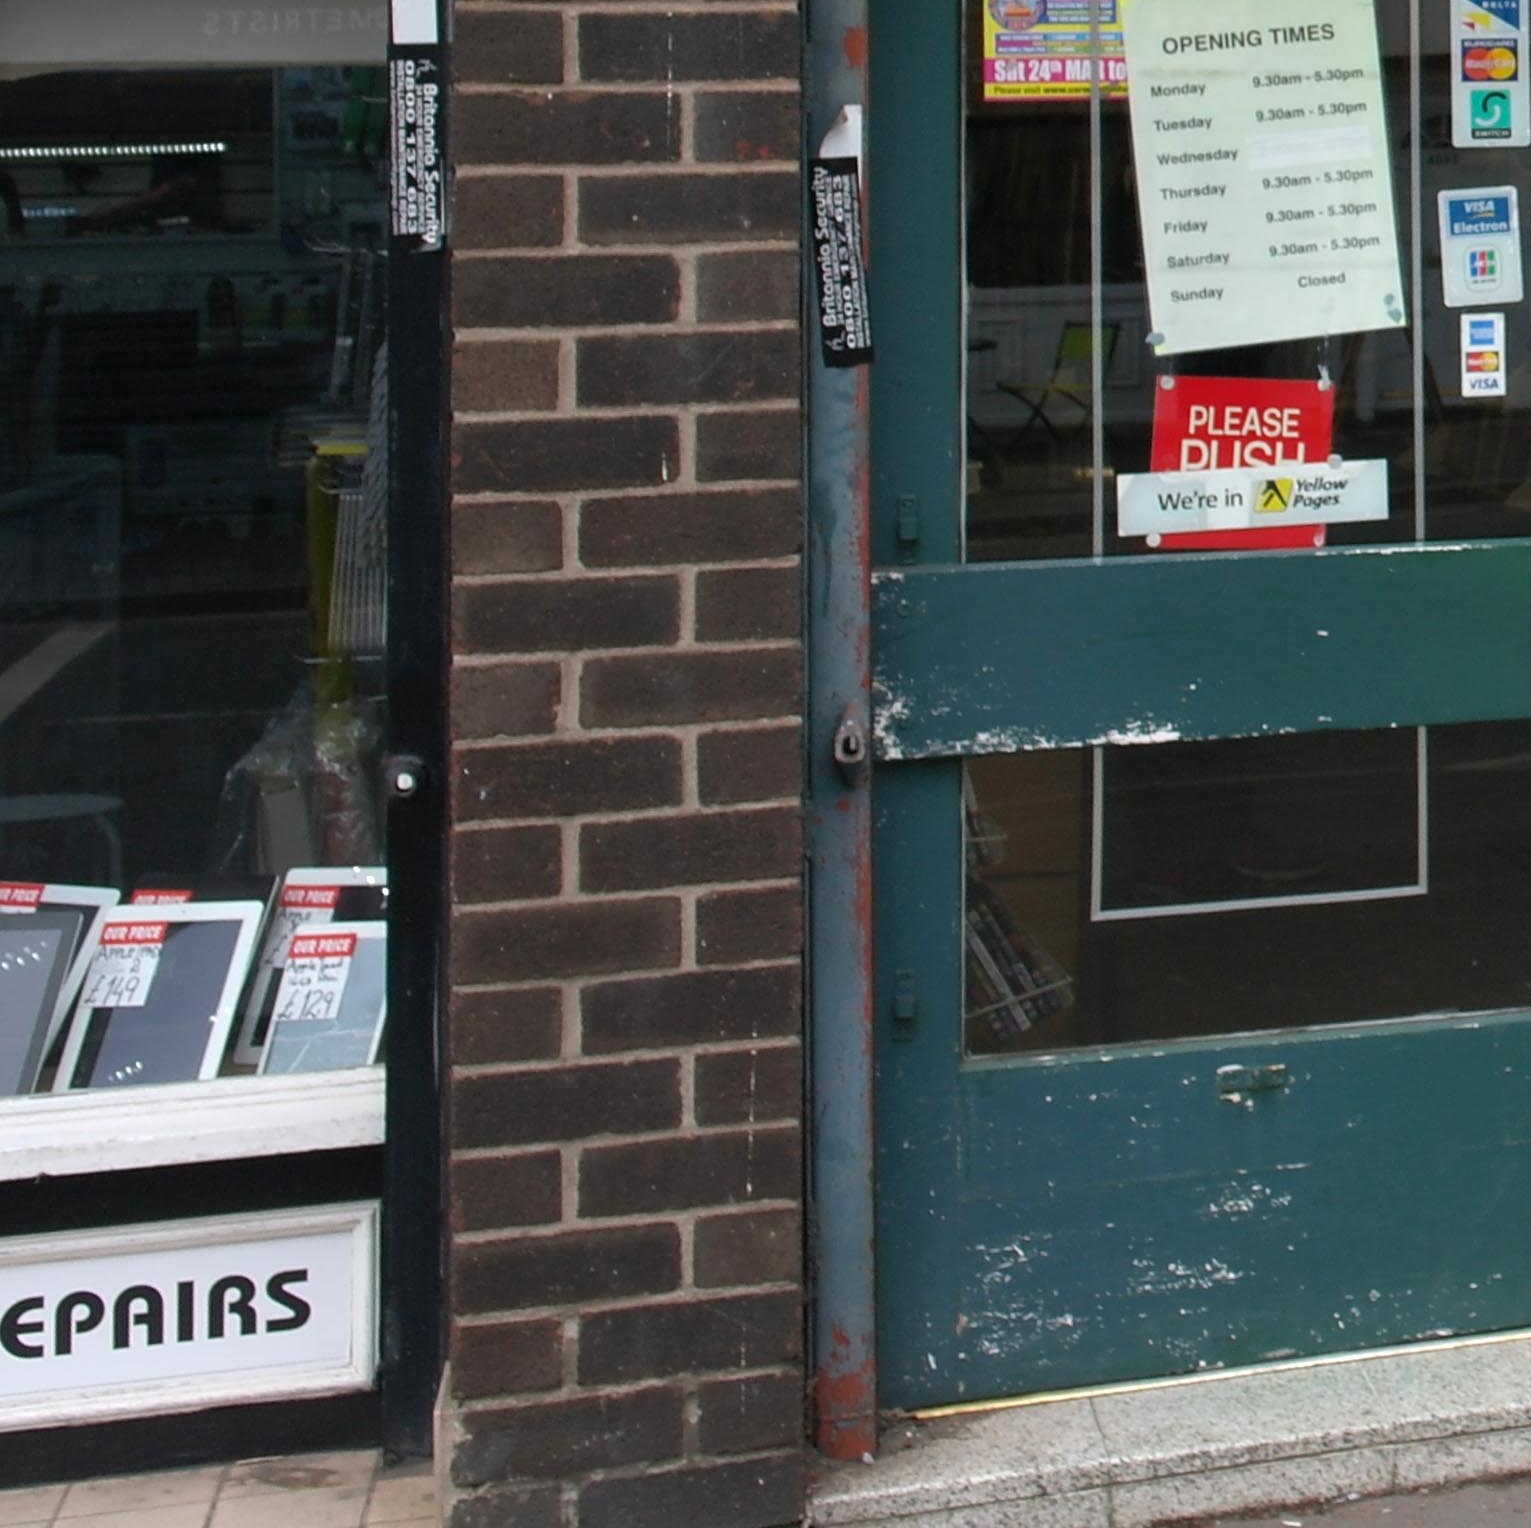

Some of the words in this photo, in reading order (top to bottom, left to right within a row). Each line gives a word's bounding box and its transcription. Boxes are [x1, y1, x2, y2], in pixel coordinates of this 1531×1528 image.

[1162, 30, 1262, 55] OPENING
[1268, 23, 1336, 45] TIMES
[994, 60, 1026, 82] Sat
[1065, 60, 1105, 81] MA
[1150, 82, 1206, 98] Monday
[1252, 74, 1302, 89] 9.30am
[1314, 67, 1364, 83] 5.30pm
[405, 60, 415, 123] 0800
[422, 83, 439, 166] Britannia
[1153, 117, 1213, 132] Tuesday
[1255, 107, 1305, 122] 9.30am
[1317, 101, 1368, 117] 5.30pm
[406, 133, 416, 178] 137
[1156, 148, 1239, 166] Wednesday
[1160, 183, 1227, 200] Thursday
[1262, 175, 1312, 190] 9.30am
[1323, 167, 1374, 185] 5.30pm
[422, 170, 440, 244] Security
[811, 166, 829, 240] Security
[1163, 219, 1208, 235] Friday
[1265, 208, 1315, 224] 9.30am
[1327, 201, 1377, 219] 5.30pm
[1463, 201, 1496, 214] VISA
[1453, 221, 1508, 235] Electron
[1167, 251, 1230, 269] Saturday
[1268, 242, 1318, 258] 9.30am
[1330, 235, 1380, 252] 5.30pm
[817, 245, 837, 328] Britannia
[1170, 287, 1224, 303] Sunday
[1297, 273, 1347, 288] Closed
[843, 286, 856, 349] 0800
[1469, 378, 1499, 390] VISA
[1188, 405, 1301, 438] PLEASE
[1180, 438, 1306, 472] PUSH
[1158, 490, 1218, 511] We're
[1225, 489, 1243, 507] in
[1295, 477, 1349, 493] Yellow
[1292, 494, 1341, 510] Pages
[104, 926, 126, 941] OUR
[128, 925, 163, 940] PRICE
[293, 939, 317, 954] OUR
[318, 938, 352, 953] PRICE
[0, 1269, 313, 1360] EPAIRS
